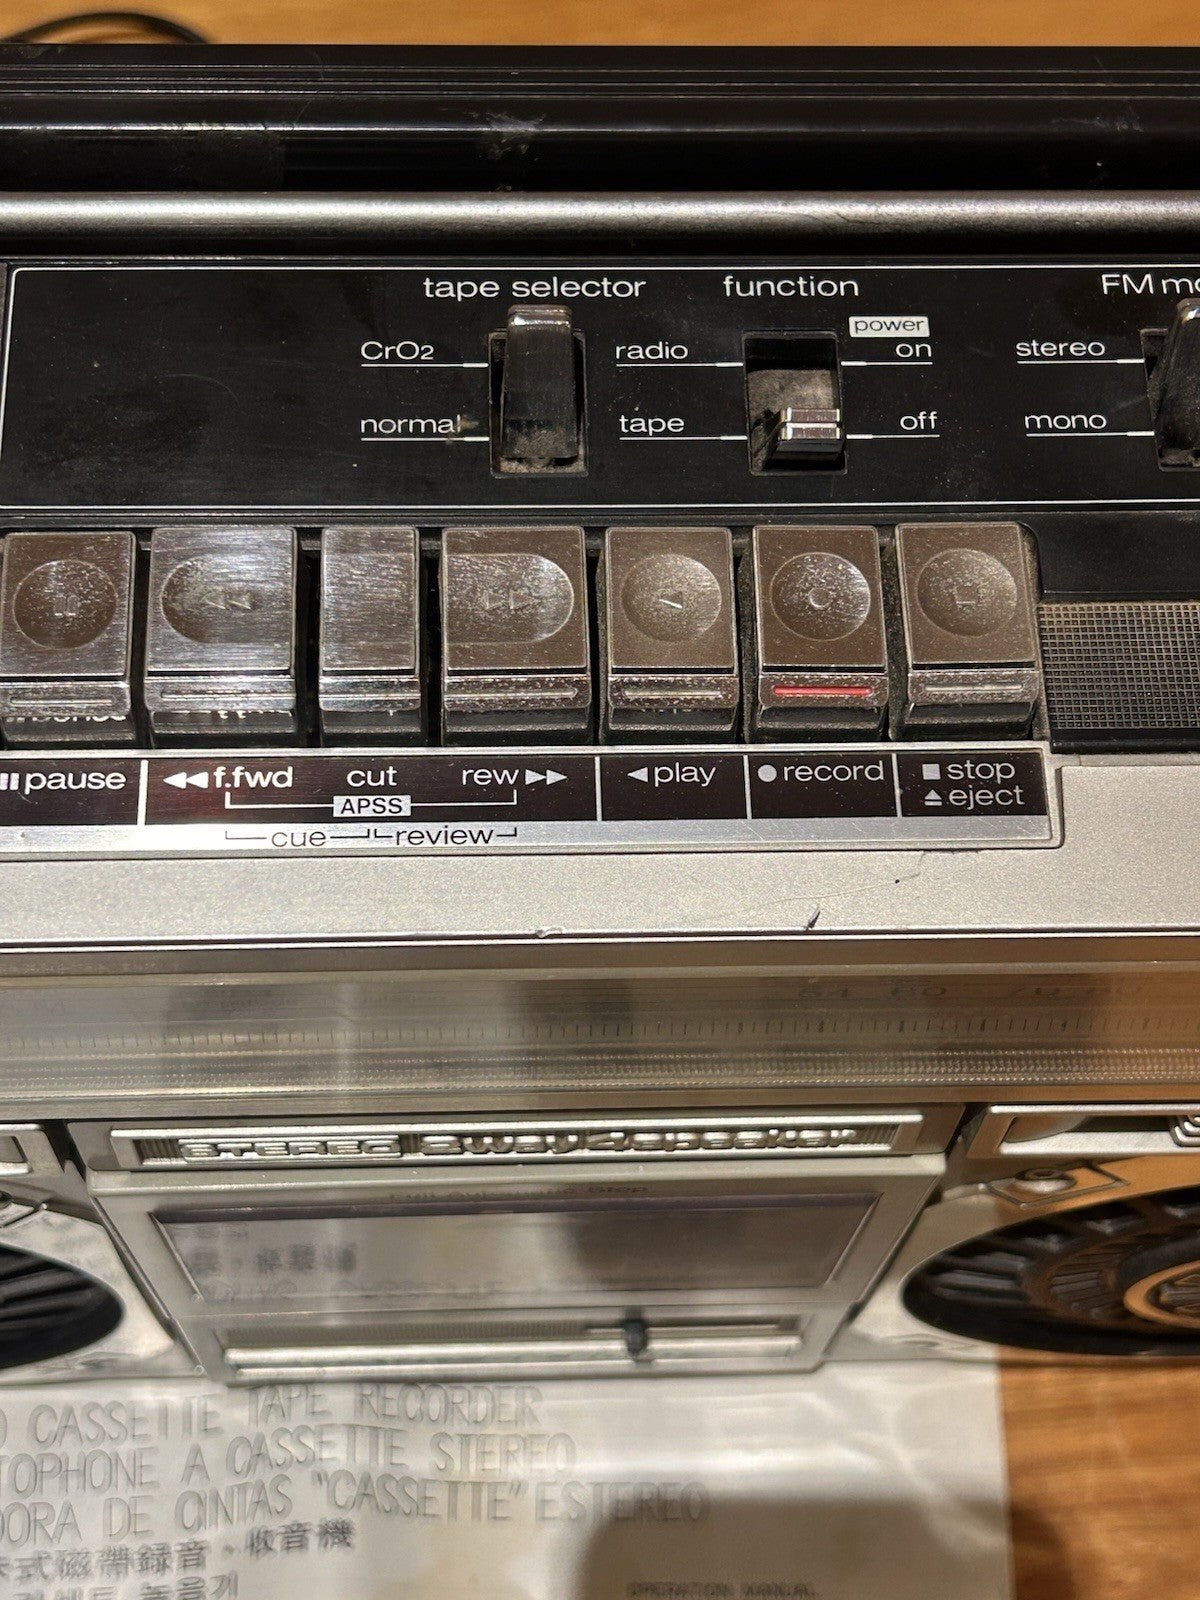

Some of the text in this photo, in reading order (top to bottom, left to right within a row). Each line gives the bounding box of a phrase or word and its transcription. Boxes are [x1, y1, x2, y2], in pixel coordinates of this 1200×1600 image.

[423, 276, 647, 301] tape selector
[722, 275, 860, 298] function
[1101, 273, 1154, 295] FM
[854, 317, 926, 335] power
[615, 340, 689, 360] radio
[895, 341, 933, 358] on
[1015, 339, 1106, 357] stereo
[360, 413, 462, 434] normal
[618, 414, 685, 437] tape
[899, 410, 938, 431] off
[1024, 413, 1107, 430] mono
[213, 766, 294, 789] f.fwd
[346, 766, 397, 787] cut
[461, 769, 520, 786] rew
[653, 762, 717, 787] play
[783, 761, 885, 783] record
[946, 761, 1016, 785] stop
[24, 772, 127, 795] pause
[340, 797, 403, 815] APSS
[948, 784, 1026, 807] eject
[270, 829, 327, 848] cue
[395, 826, 494, 846] review
[180, 1138, 402, 1159] STEREO
[248, 1384, 332, 1427] TAPE
[353, 1382, 544, 1427] RECORDER
[180, 1442, 211, 1486] A
[226, 1423, 409, 1478] CASSETTE
[429, 1431, 578, 1474] STEREO
[0, 1500, 83, 1548] ORA
[103, 1495, 154, 1542] DE
[174, 1473, 293, 1535] CINTAS
[534, 1480, 712, 1523] ESTEREO
